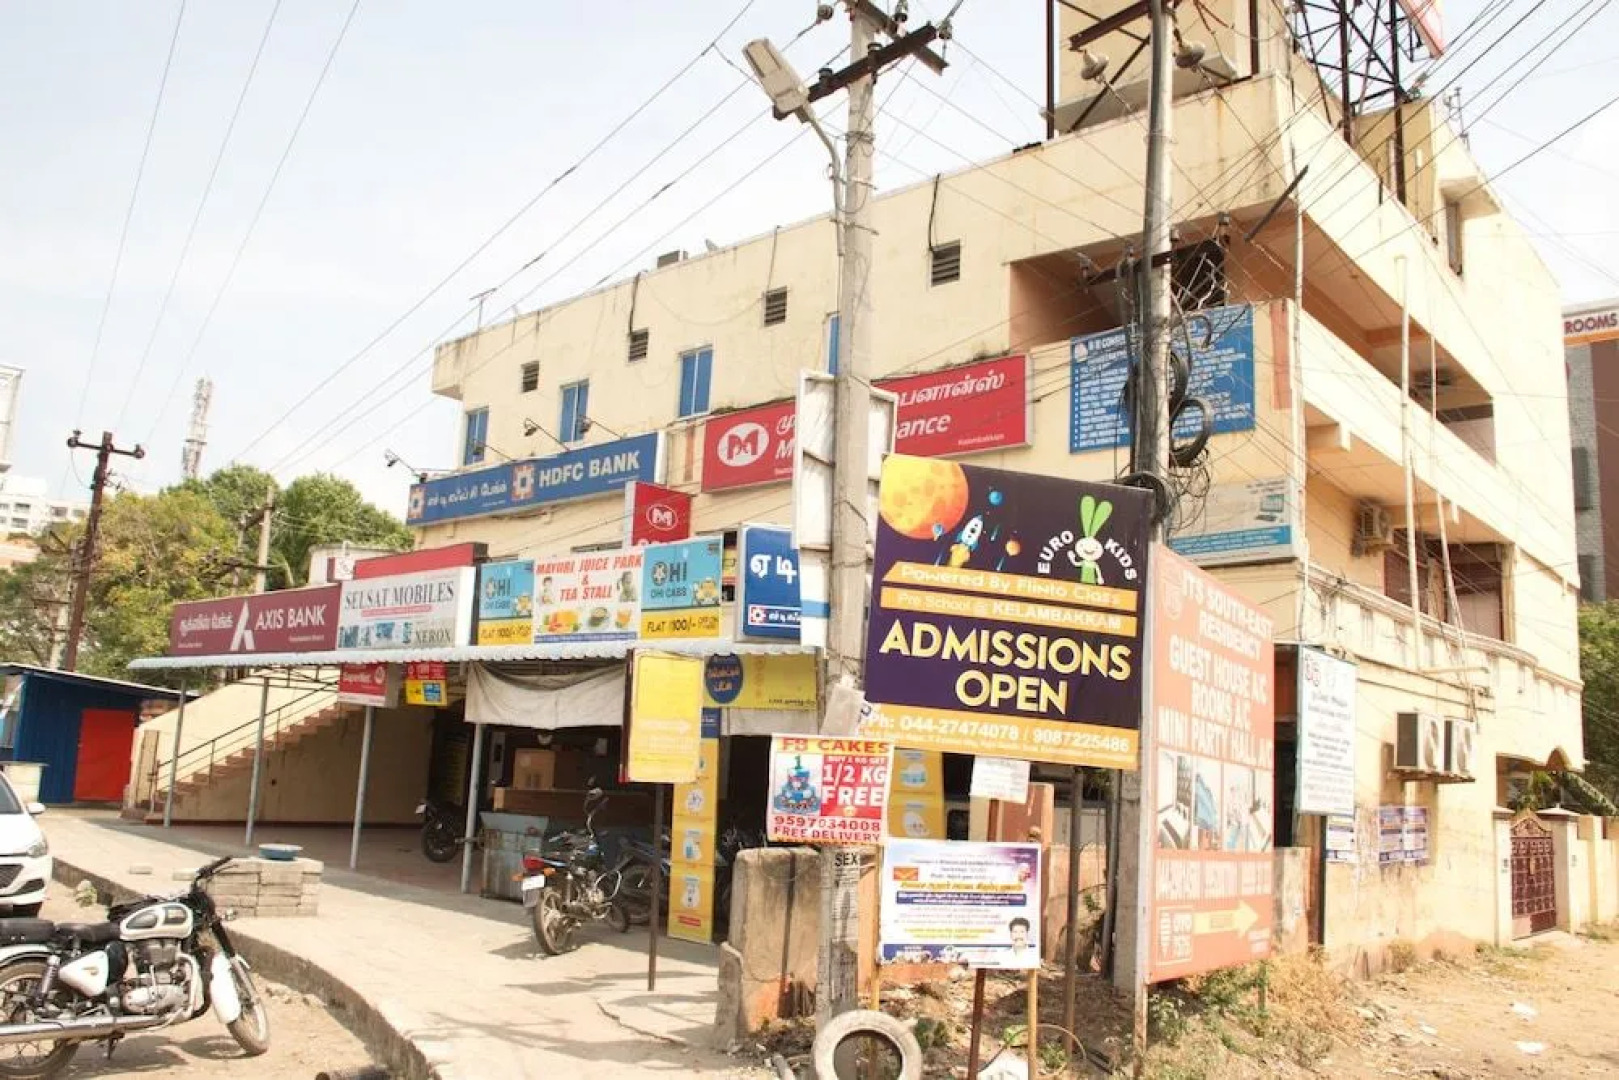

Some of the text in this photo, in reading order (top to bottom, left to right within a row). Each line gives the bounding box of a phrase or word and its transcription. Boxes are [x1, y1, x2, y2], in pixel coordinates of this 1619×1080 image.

[1564, 312, 1617, 334] ROOMS
[894, 413, 951, 439] ance
[539, 450, 640, 488] HDFC BANK
[536, 554, 643, 575] MAYURI JUICE PARK
[1037, 530, 1074, 574] EURO
[1104, 538, 1137, 580] KIDS
[581, 574, 589, 585] &
[651, 560, 688, 586] OHI
[901, 566, 984, 589] Powered
[989, 577, 1010, 593] By
[1016, 579, 1068, 598] Flinto
[345, 581, 454, 609] SELSAT MOBILES
[560, 585, 612, 602] TEA STALL
[650, 586, 687, 598] OHI CABS
[255, 604, 327, 630] AXIS BANK
[898, 592, 921, 607] Pre
[925, 594, 970, 611] School
[992, 600, 1122, 630] KELAMBAKKAM
[415, 627, 452, 644] XEROX
[647, 621, 667, 632] FLAT
[1199, 609, 1262, 661] RESIDENCY
[879, 619, 1132, 681] ADMISSIONS
[1169, 633, 1211, 681] GUEST
[1213, 653, 1251, 698] HOUSE
[955, 669, 1068, 715] OPEN
[1191, 680, 1231, 726] ROOMS
[818, 739, 890, 753] CAKES
[899, 714, 1020, 739] 044-27474078
[1033, 728, 1129, 752] 9087225486
[1158, 706, 1189, 748] MINI
[1190, 716, 1229, 760] PARTY
[1230, 728, 1257, 765] HALL
[823, 762, 886, 787] 1/2 KG
[821, 786, 883, 807] FREE
[774, 815, 881, 832] 9597034008
[774, 826, 808, 838] FREE
[812, 829, 880, 843] DELIVERY
[835, 853, 858, 867] SEX
